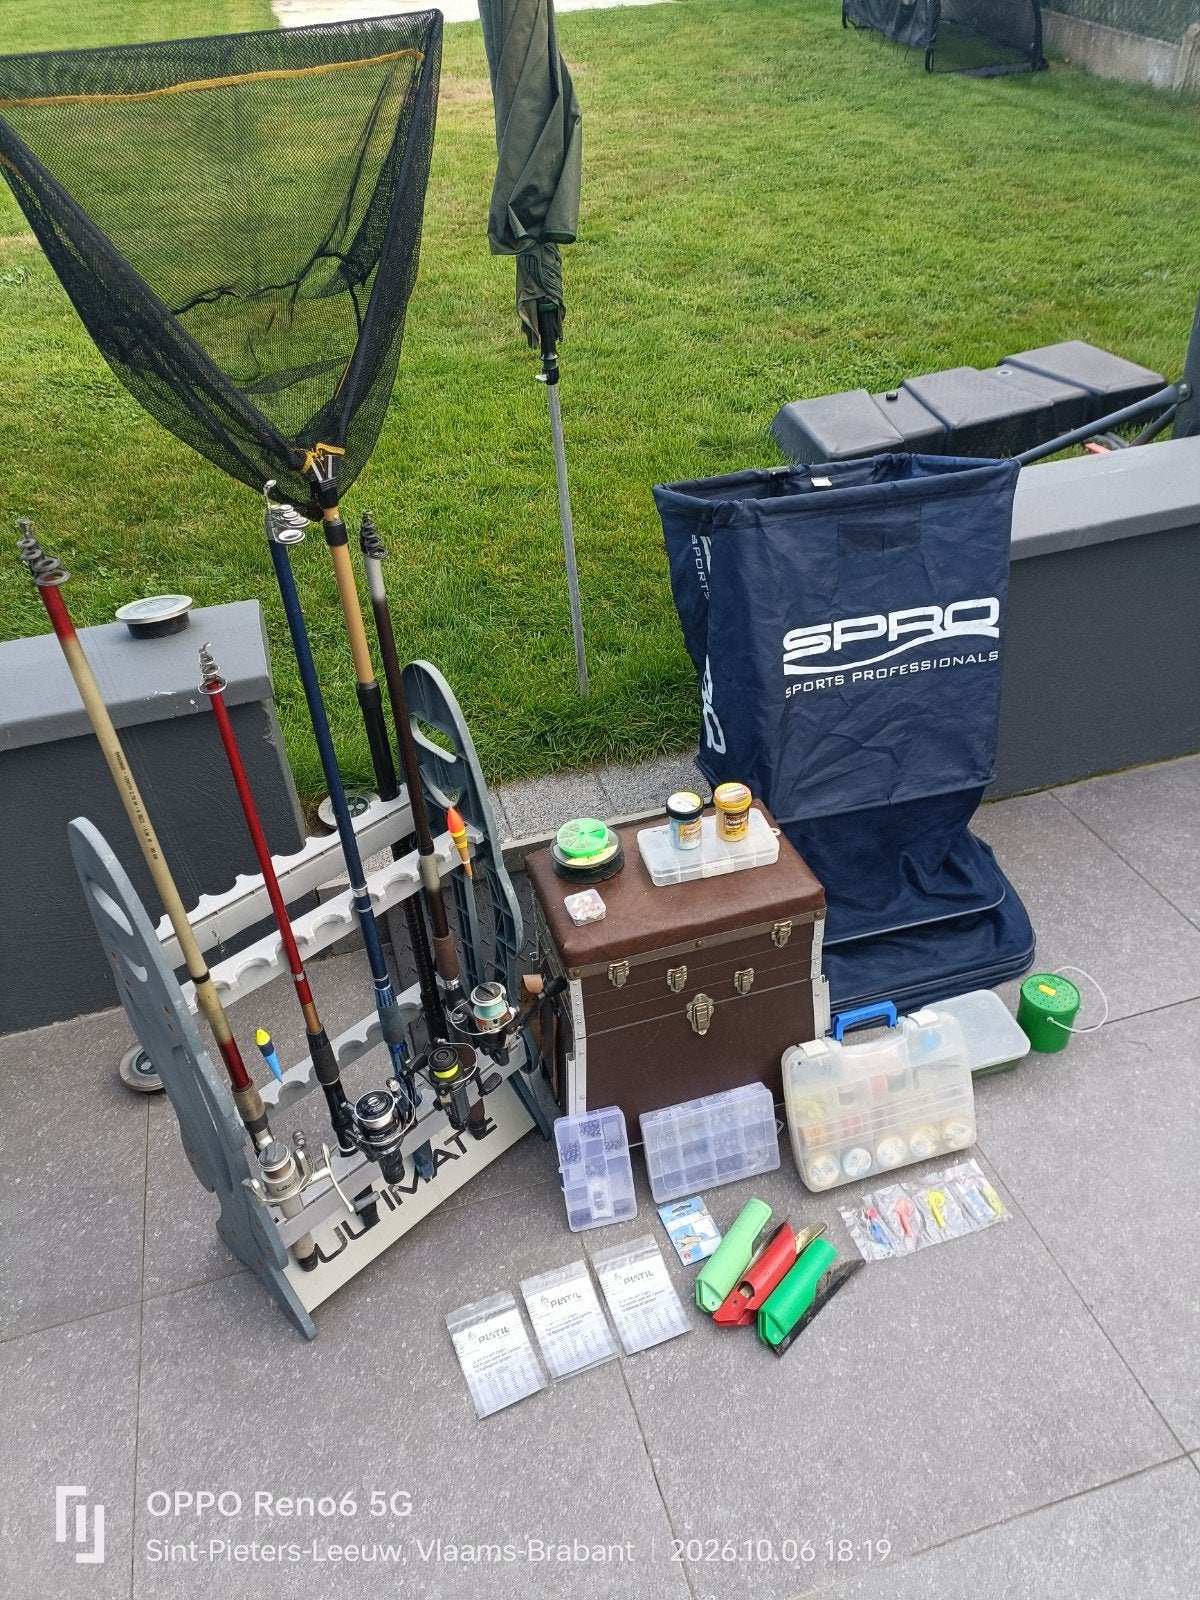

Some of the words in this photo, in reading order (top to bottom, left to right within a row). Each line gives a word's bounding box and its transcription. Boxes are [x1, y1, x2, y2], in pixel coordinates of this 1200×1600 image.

[783, 597, 999, 662] SPRO
[785, 674, 845, 699] SPORTS
[852, 650, 999, 683] PROFESSIONALS
[315, 1116, 498, 1264] ULIMATE
